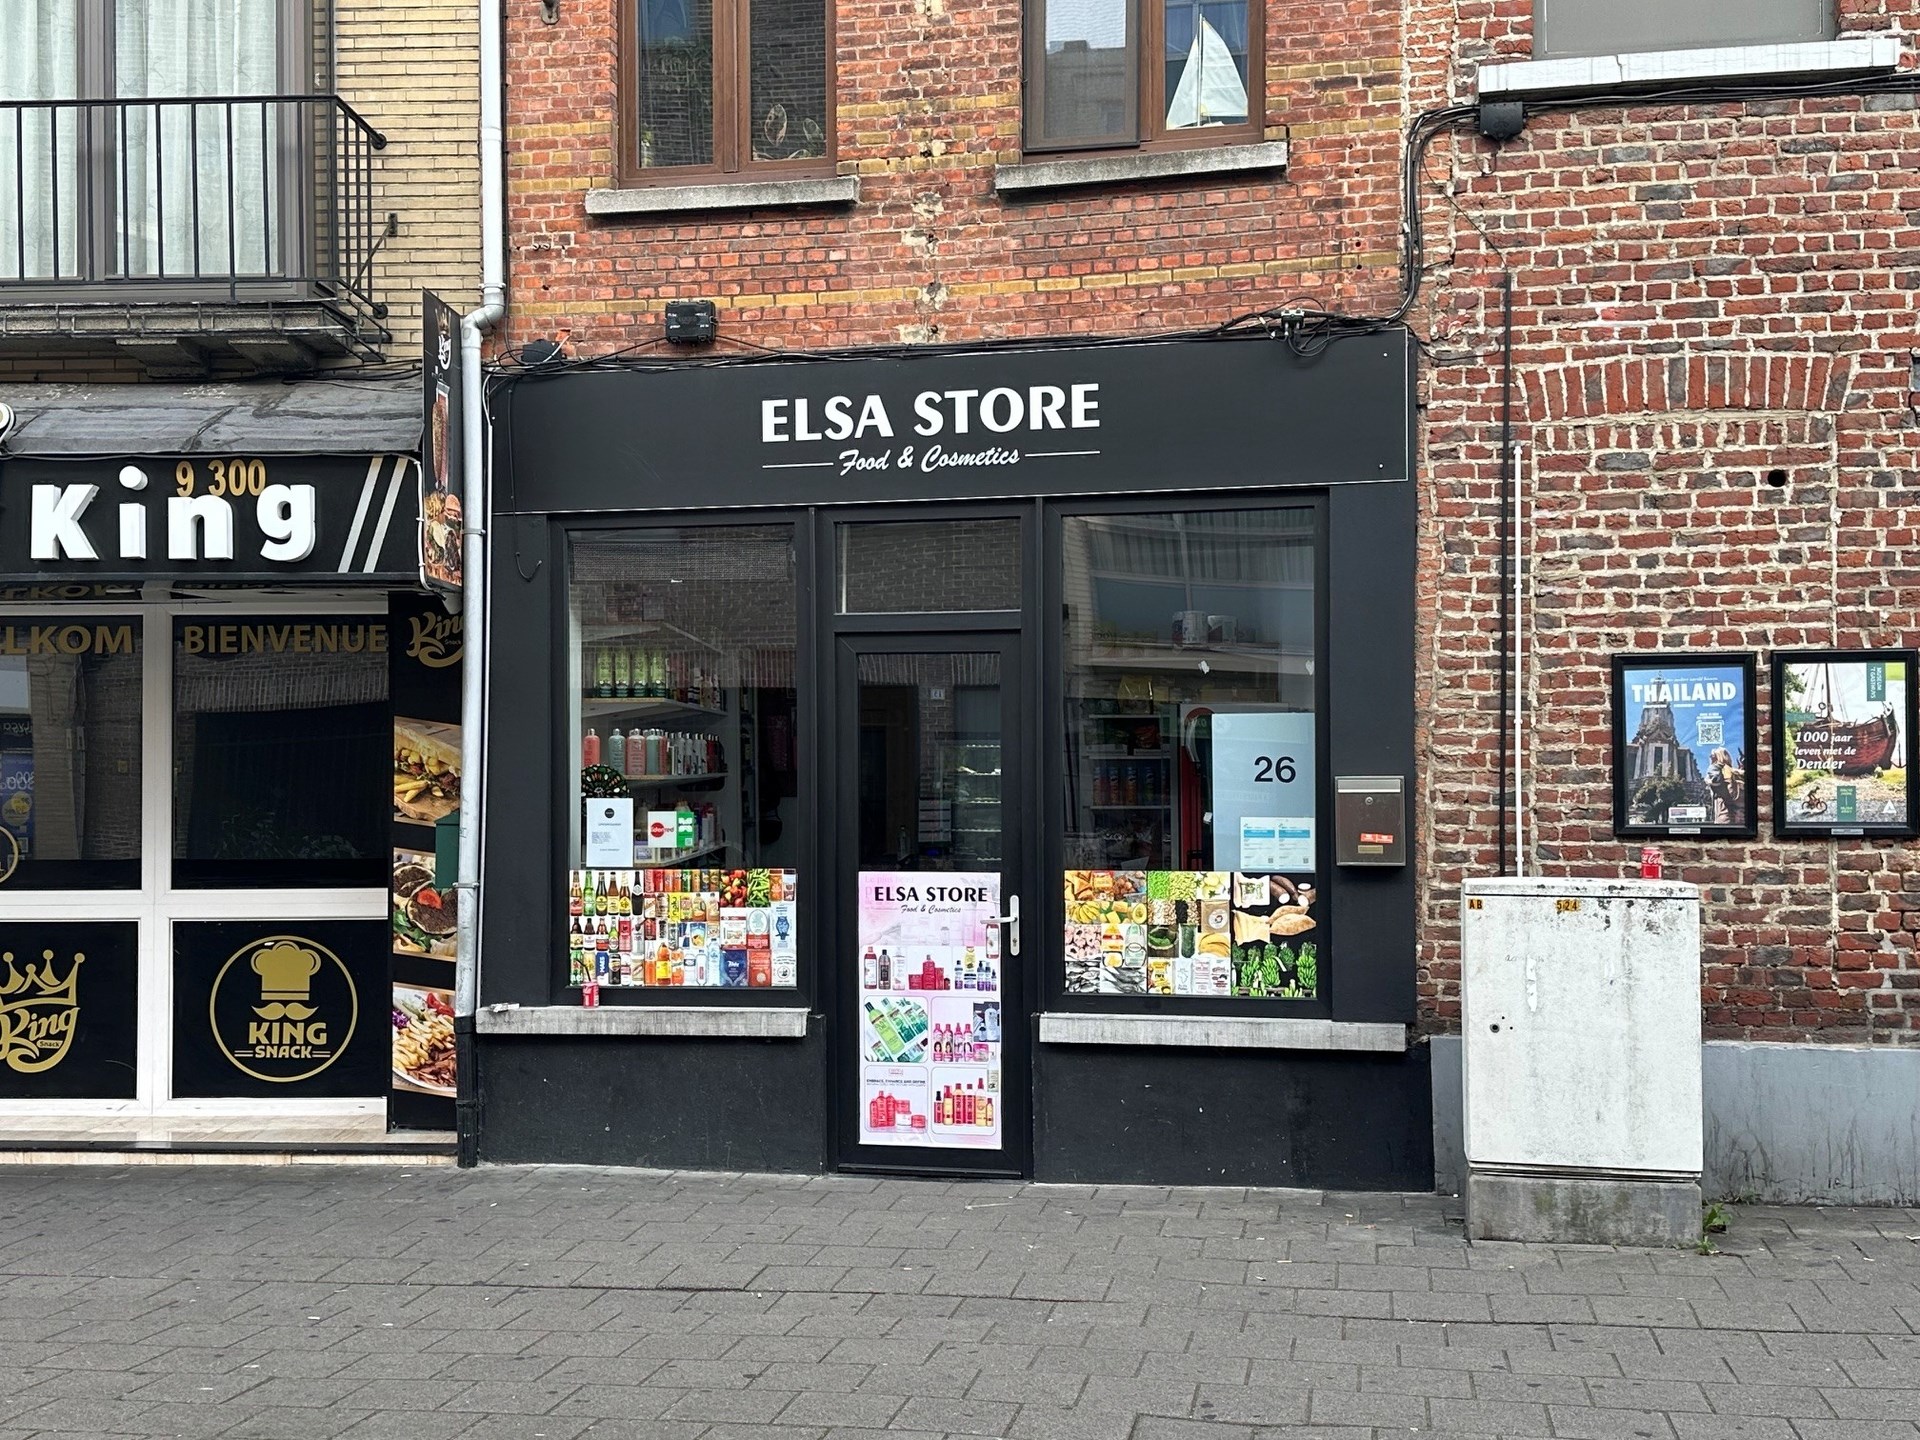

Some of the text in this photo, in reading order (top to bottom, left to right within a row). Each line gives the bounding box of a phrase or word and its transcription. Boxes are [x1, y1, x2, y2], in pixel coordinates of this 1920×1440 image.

[762, 383, 1100, 443] ELSA STORE
[838, 444, 1020, 477] Food & Cosmetics
[175, 459, 266, 498] 9 300
[31, 465, 316, 562] King
[0, 625, 133, 654] LKOM
[184, 624, 388, 654] BIENVENUE
[406, 611, 464, 668] Kin
[1631, 682, 1737, 703] THAILAND
[1794, 746, 1857, 756] leven met de
[1831, 733, 1853, 746] jaar
[1254, 756, 1297, 784] 26
[1795, 759, 1846, 770] Dender
[874, 886, 988, 902] ELSA STORE
[1469, 899, 1578, 911] AB 524
[901, 904, 961, 914] Food & Cosmetics
[0, 1007, 80, 1073] King
[39, 1040, 60, 1048] Snack
[248, 1022, 327, 1045] KING
[255, 1045, 312, 1060] SNACK
